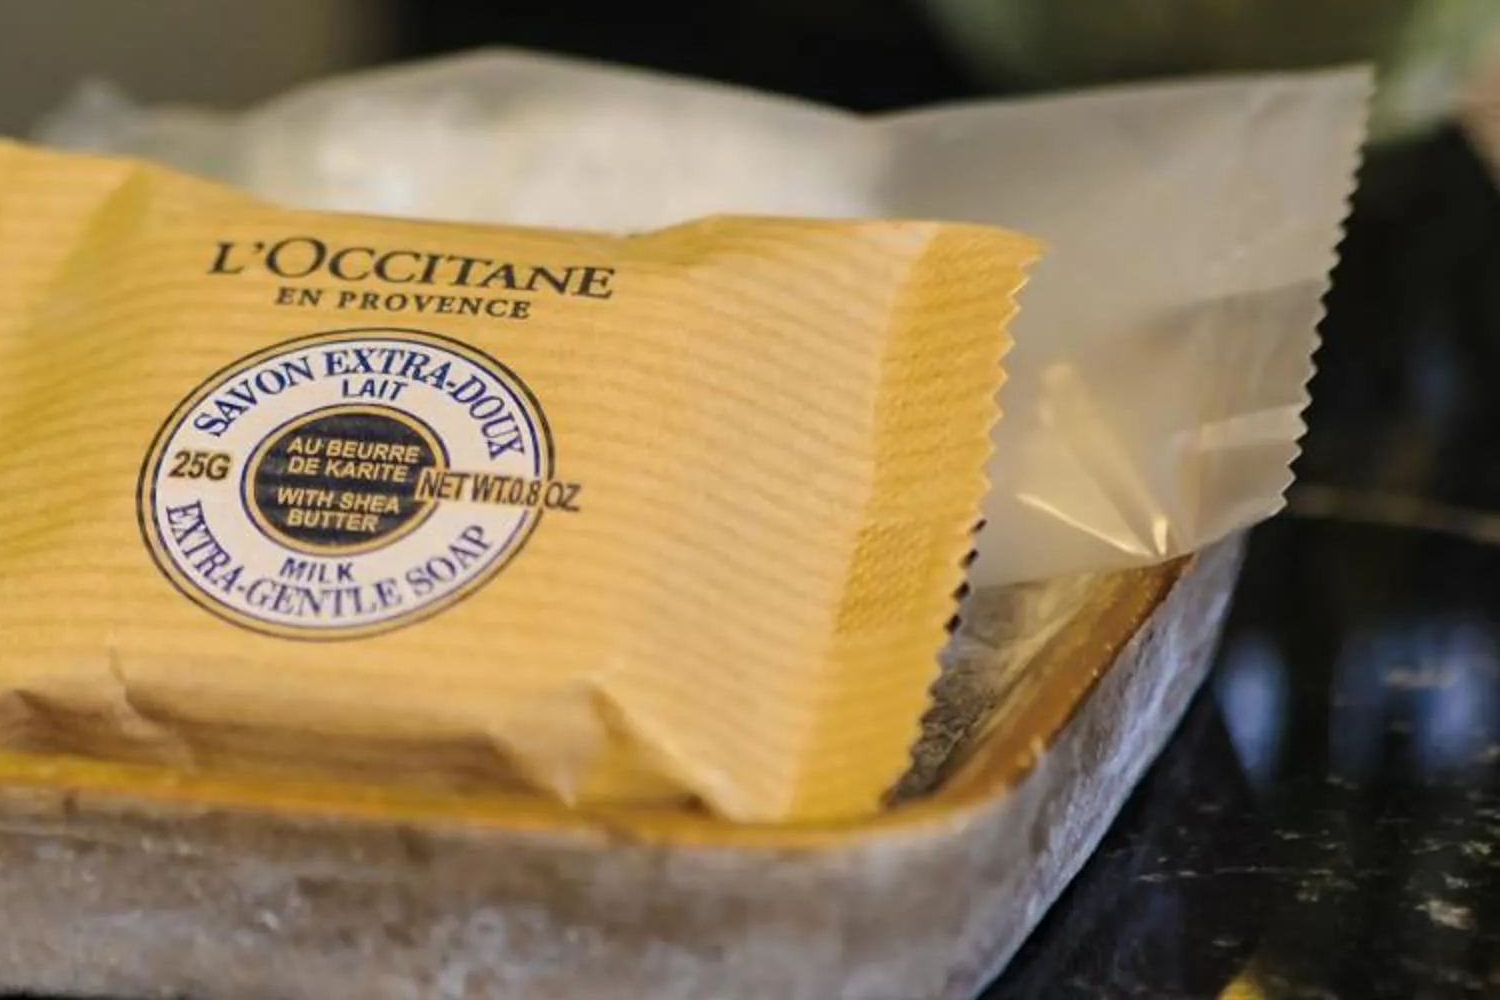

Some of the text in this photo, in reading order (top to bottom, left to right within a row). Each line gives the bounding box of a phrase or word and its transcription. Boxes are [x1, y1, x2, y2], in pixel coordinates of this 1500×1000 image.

[206, 237, 616, 300] L'OCCITANE
[274, 287, 531, 320] EN PROVENCE
[193, 346, 526, 461] SAVON EXTRA-DOUX
[340, 379, 410, 400] LAIT
[286, 436, 422, 464] AU BEURRE
[167, 449, 233, 483] 25G
[287, 456, 410, 484] DE KARITE
[276, 486, 402, 516] WITH SHEA
[419, 470, 470, 502] NET
[543, 480, 583, 513] OZ
[286, 508, 381, 534] BUTTER
[165, 499, 494, 619] EXTRA-GENTLE SOAP
[279, 557, 355, 582] MILK
